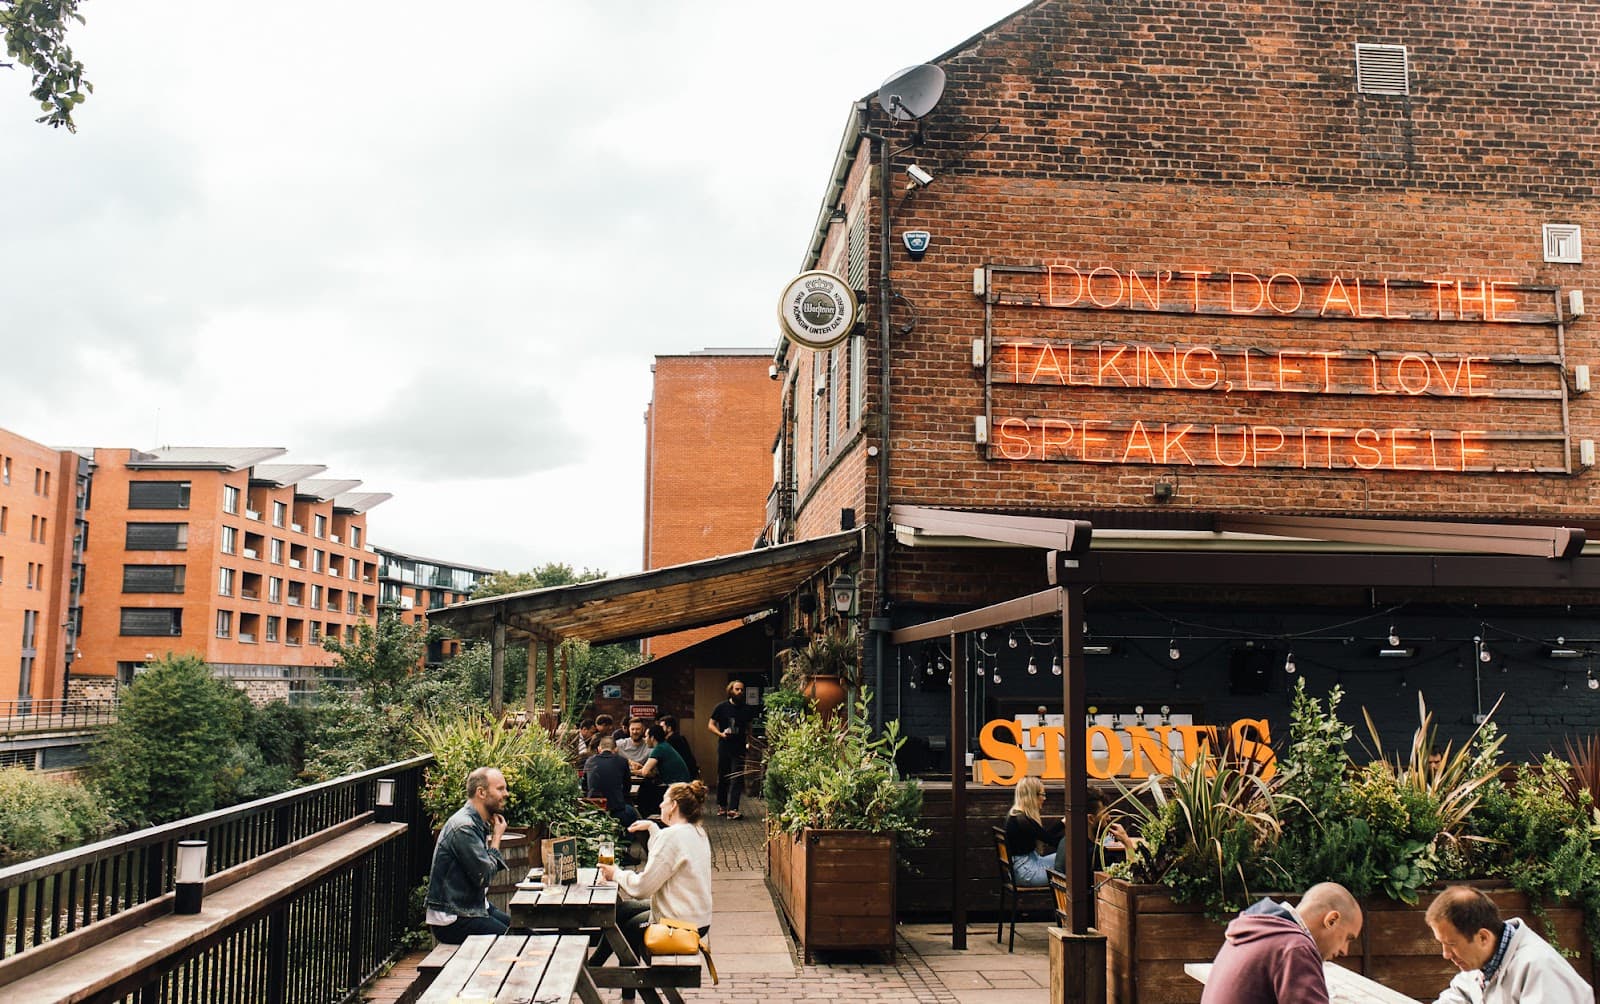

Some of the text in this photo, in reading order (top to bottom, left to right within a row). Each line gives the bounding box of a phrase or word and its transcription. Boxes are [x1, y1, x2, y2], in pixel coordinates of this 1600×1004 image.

[1048, 264, 1521, 322] DON'T DO ALL THE
[809, 327, 832, 335] UNTER
[831, 316, 842, 330] DEN
[1245, 350, 1341, 393] LET
[1372, 355, 1494, 396] LOVE
[1000, 418, 1487, 472] SPEAK UP ITSELF
